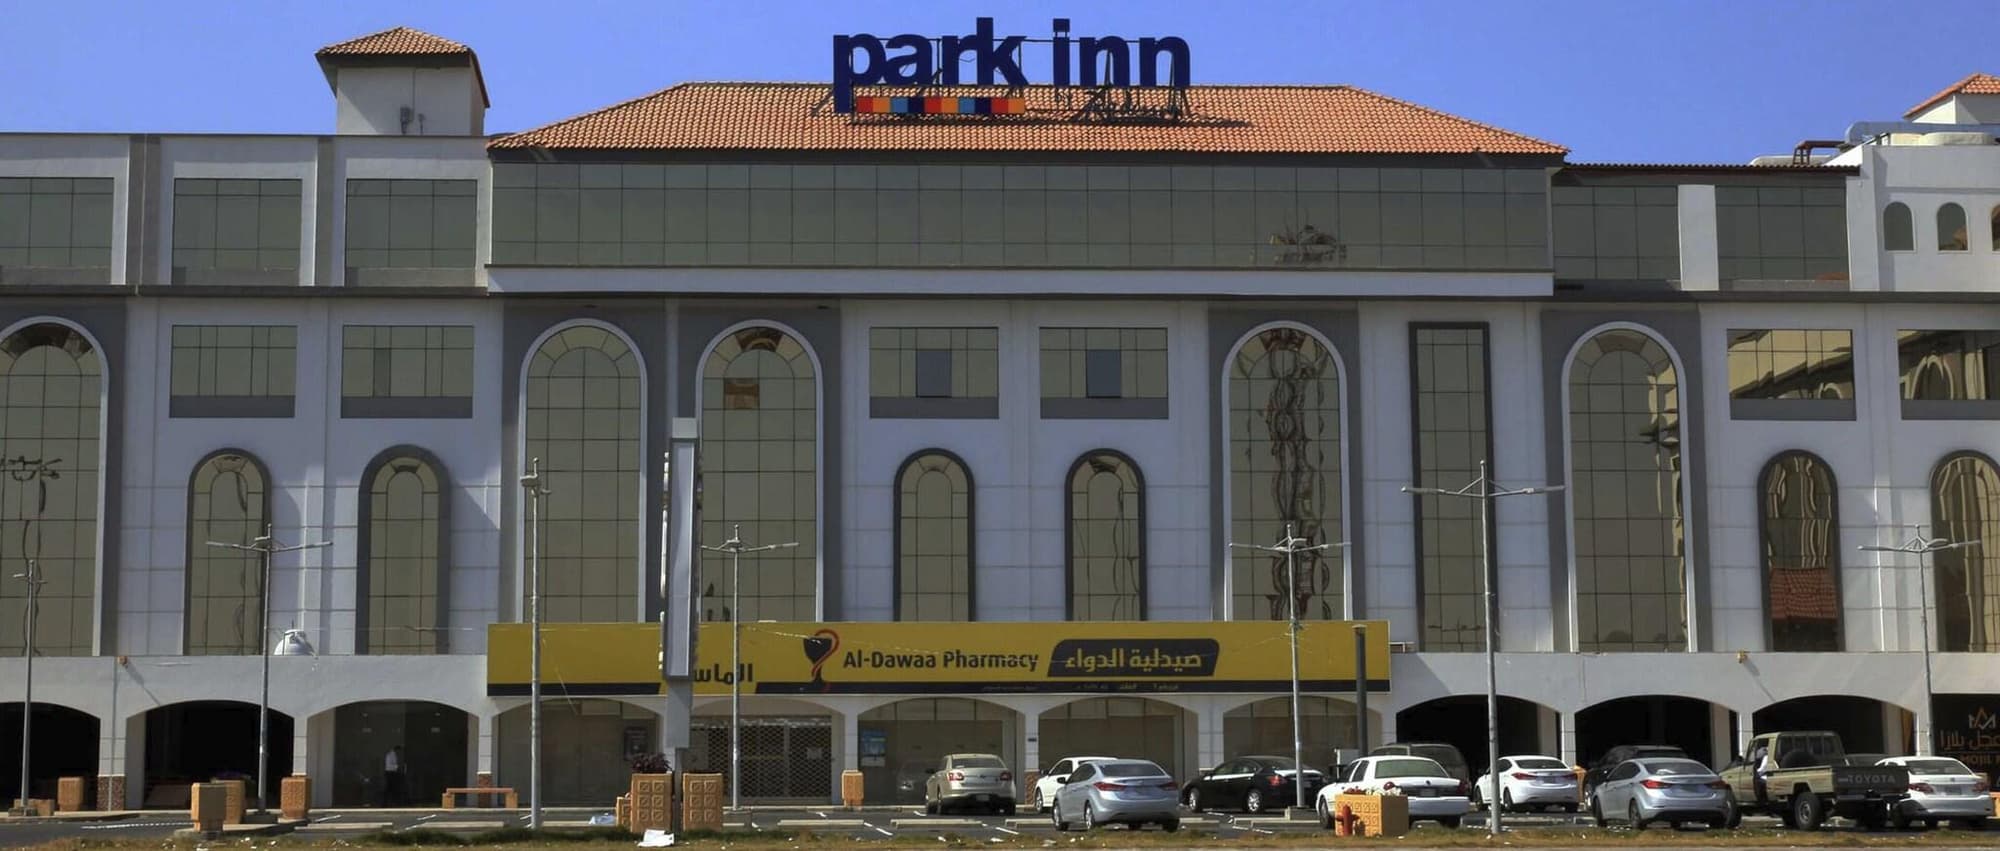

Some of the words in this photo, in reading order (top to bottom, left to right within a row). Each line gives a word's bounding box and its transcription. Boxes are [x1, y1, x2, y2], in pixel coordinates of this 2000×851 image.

[833, 17, 1028, 113] park
[1053, 18, 1190, 87] inn
[843, 649, 936, 668] Al-Dawaa
[943, 650, 1039, 672] Pharmacy
[1065, 648, 1124, 672] الدواء
[1129, 648, 1201, 672] صيدلية
[1848, 774, 1896, 784] TOYOTA
